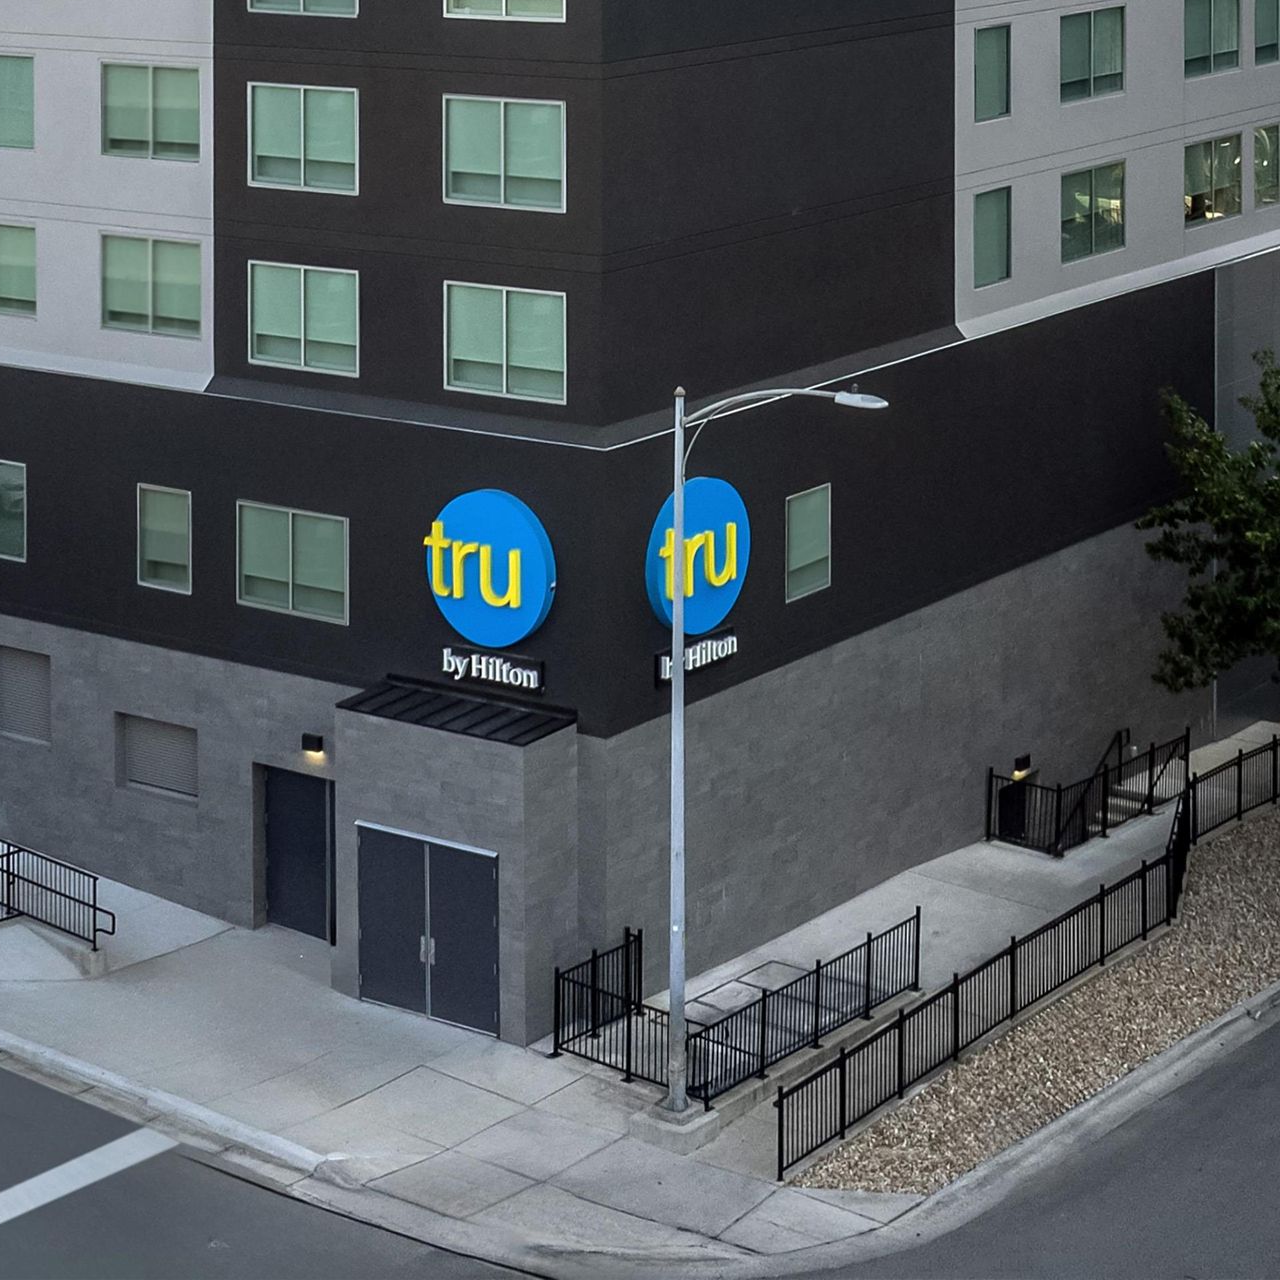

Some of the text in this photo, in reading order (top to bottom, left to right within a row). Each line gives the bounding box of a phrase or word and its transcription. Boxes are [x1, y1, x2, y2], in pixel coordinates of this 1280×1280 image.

[423, 520, 522, 608] tru
[658, 522, 737, 600] tru
[442, 647, 539, 689] by Hilton
[685, 636, 738, 671] Hilton
